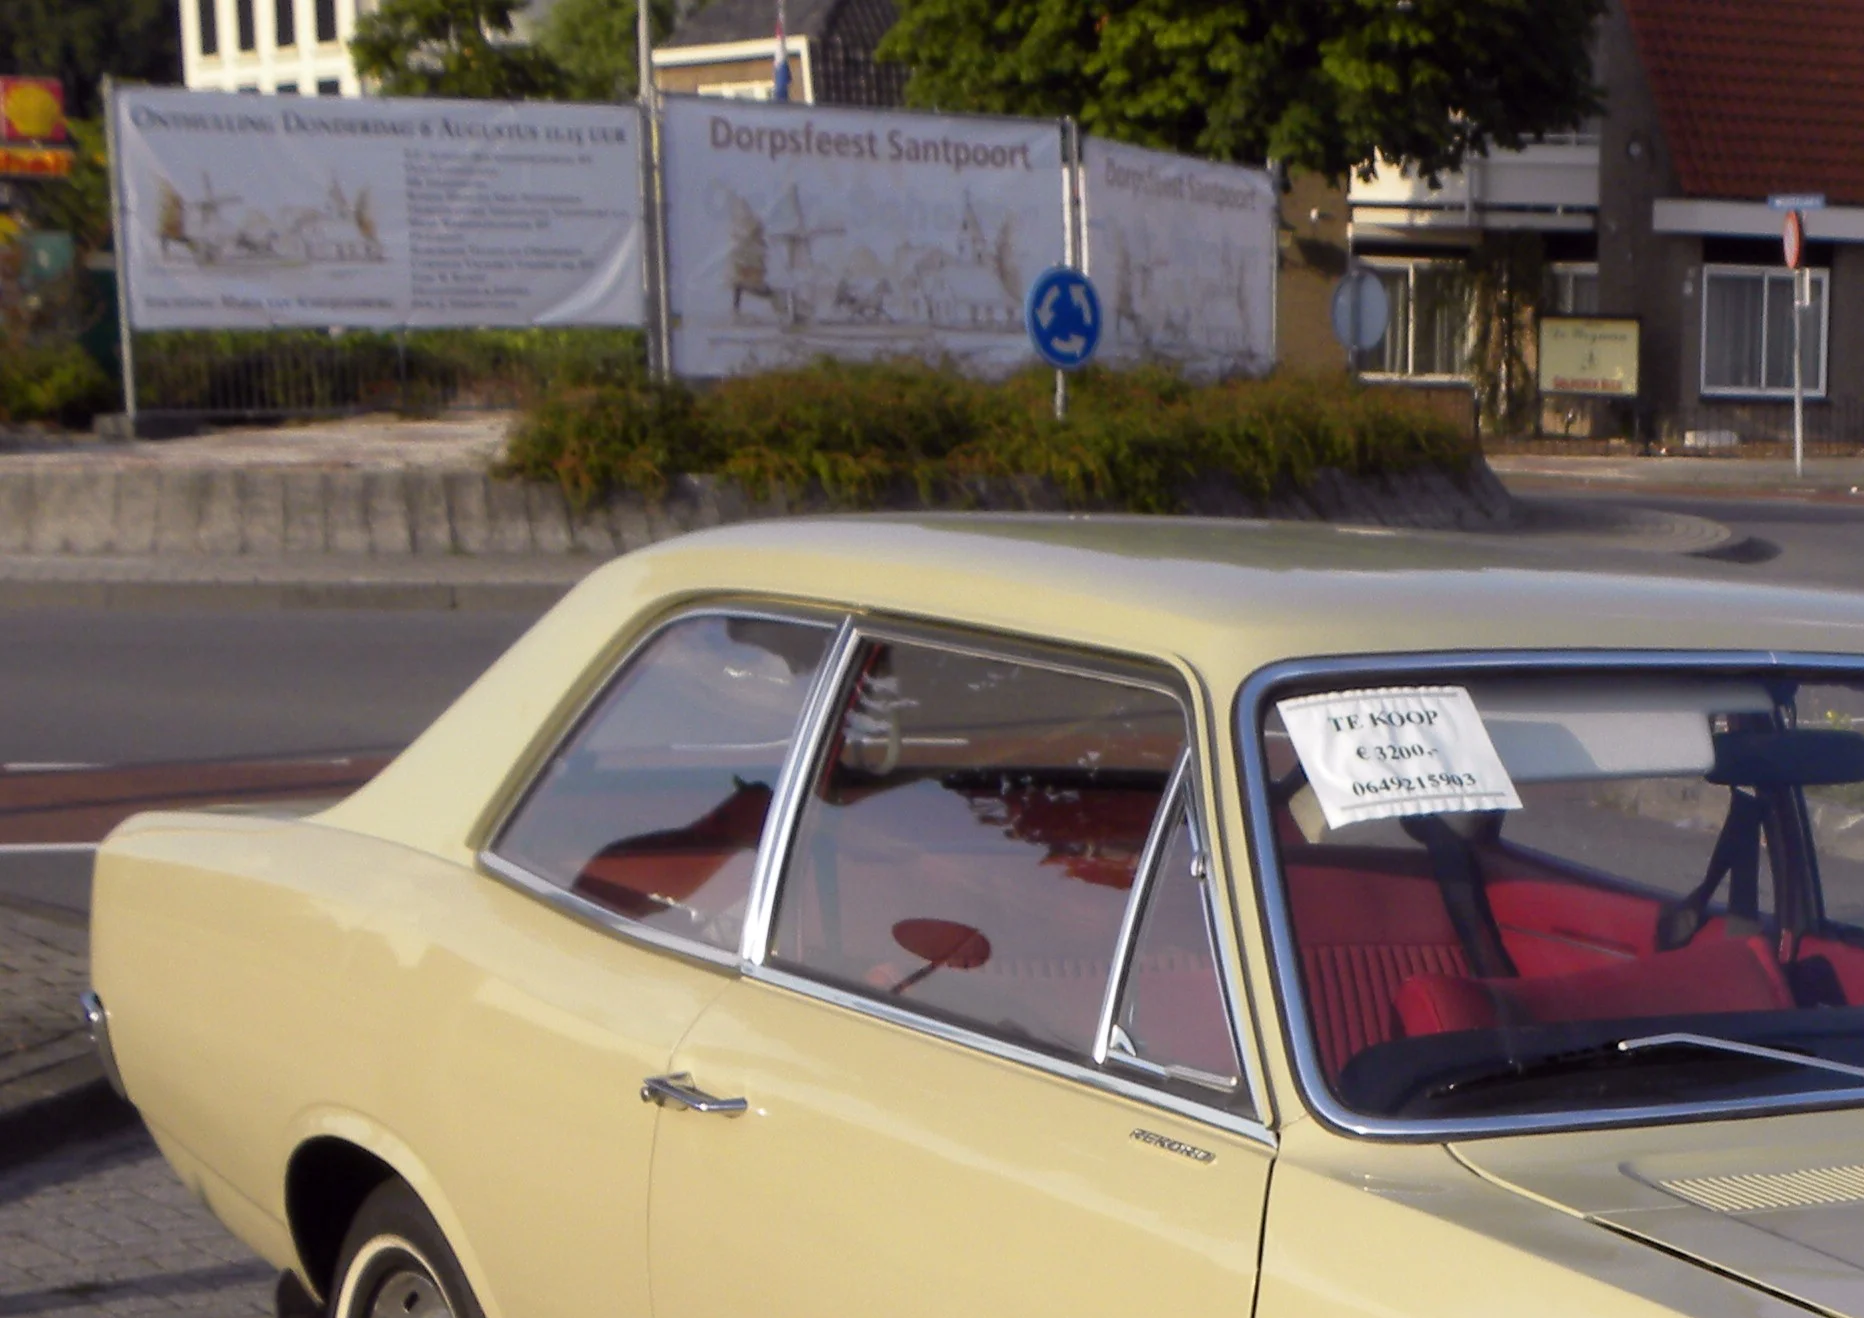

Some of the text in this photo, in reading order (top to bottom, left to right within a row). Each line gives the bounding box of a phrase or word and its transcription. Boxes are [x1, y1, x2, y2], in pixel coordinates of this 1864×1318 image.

[709, 115, 1033, 172] Dorpsfeest Santpoort
[1328, 709, 1439, 733] TE KOOP
[1355, 743, 1439, 762] € 3200,-
[1351, 772, 1477, 797] 0649215903
